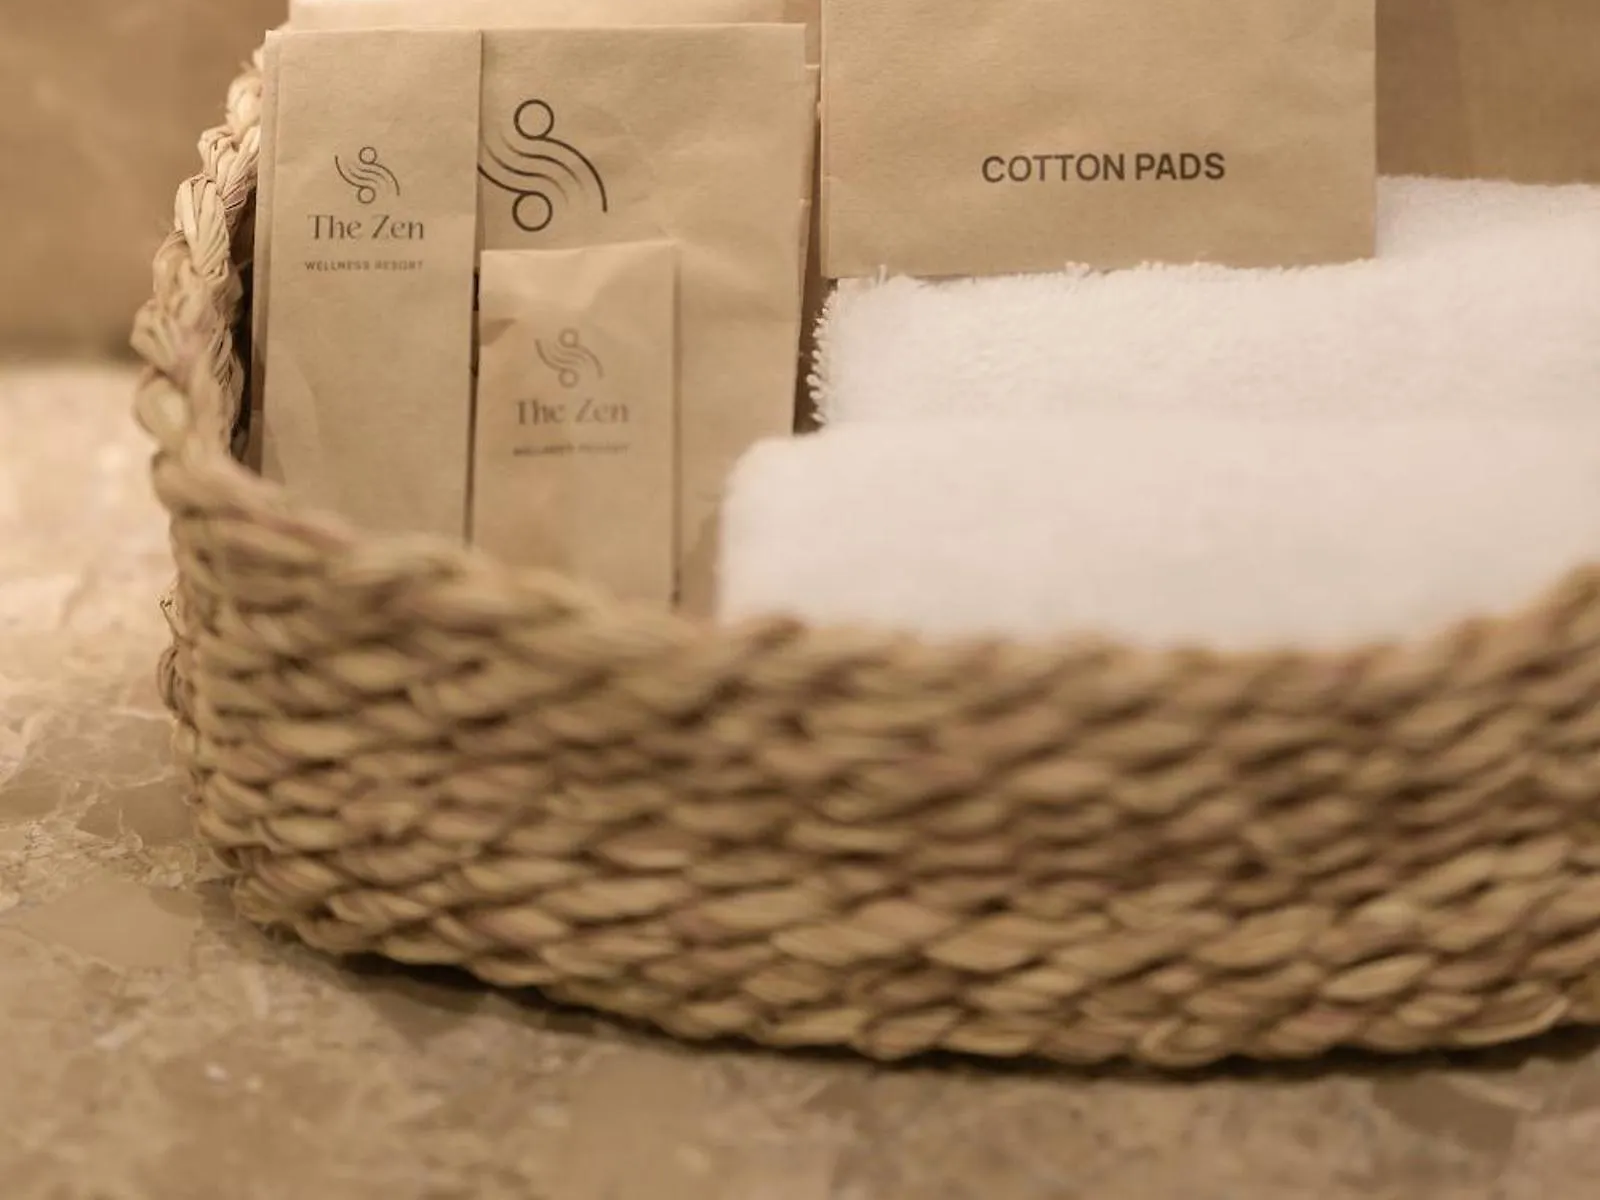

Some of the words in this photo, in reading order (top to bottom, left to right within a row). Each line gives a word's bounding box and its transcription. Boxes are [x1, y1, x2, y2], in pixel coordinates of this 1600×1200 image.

[982, 153, 1124, 183] COTTON
[1135, 152, 1225, 181] PADS
[307, 214, 363, 240] The
[371, 214, 424, 239] Zen
